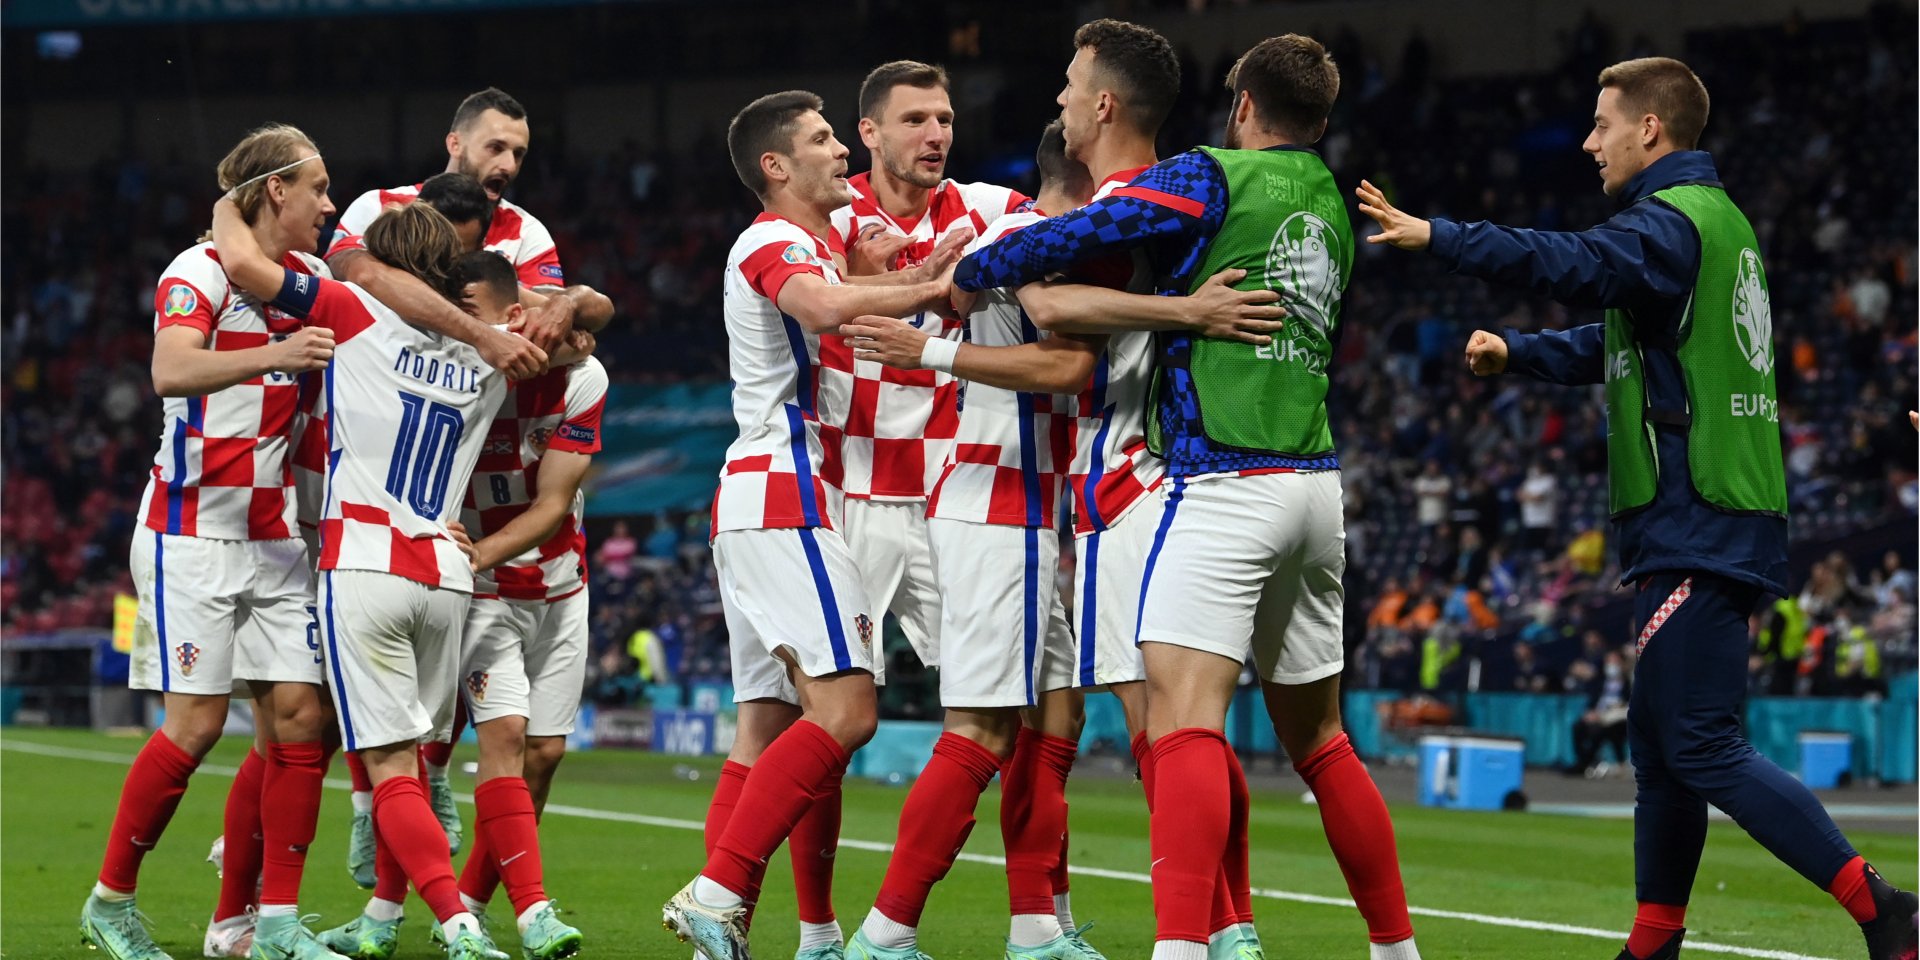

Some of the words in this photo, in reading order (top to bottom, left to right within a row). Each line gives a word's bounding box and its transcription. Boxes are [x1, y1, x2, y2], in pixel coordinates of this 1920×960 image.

[394, 346, 480, 393] MODRIĆ
[571, 429, 595, 440] RESPEC
[385, 390, 465, 522] 10
[489, 474, 512, 505] 8
